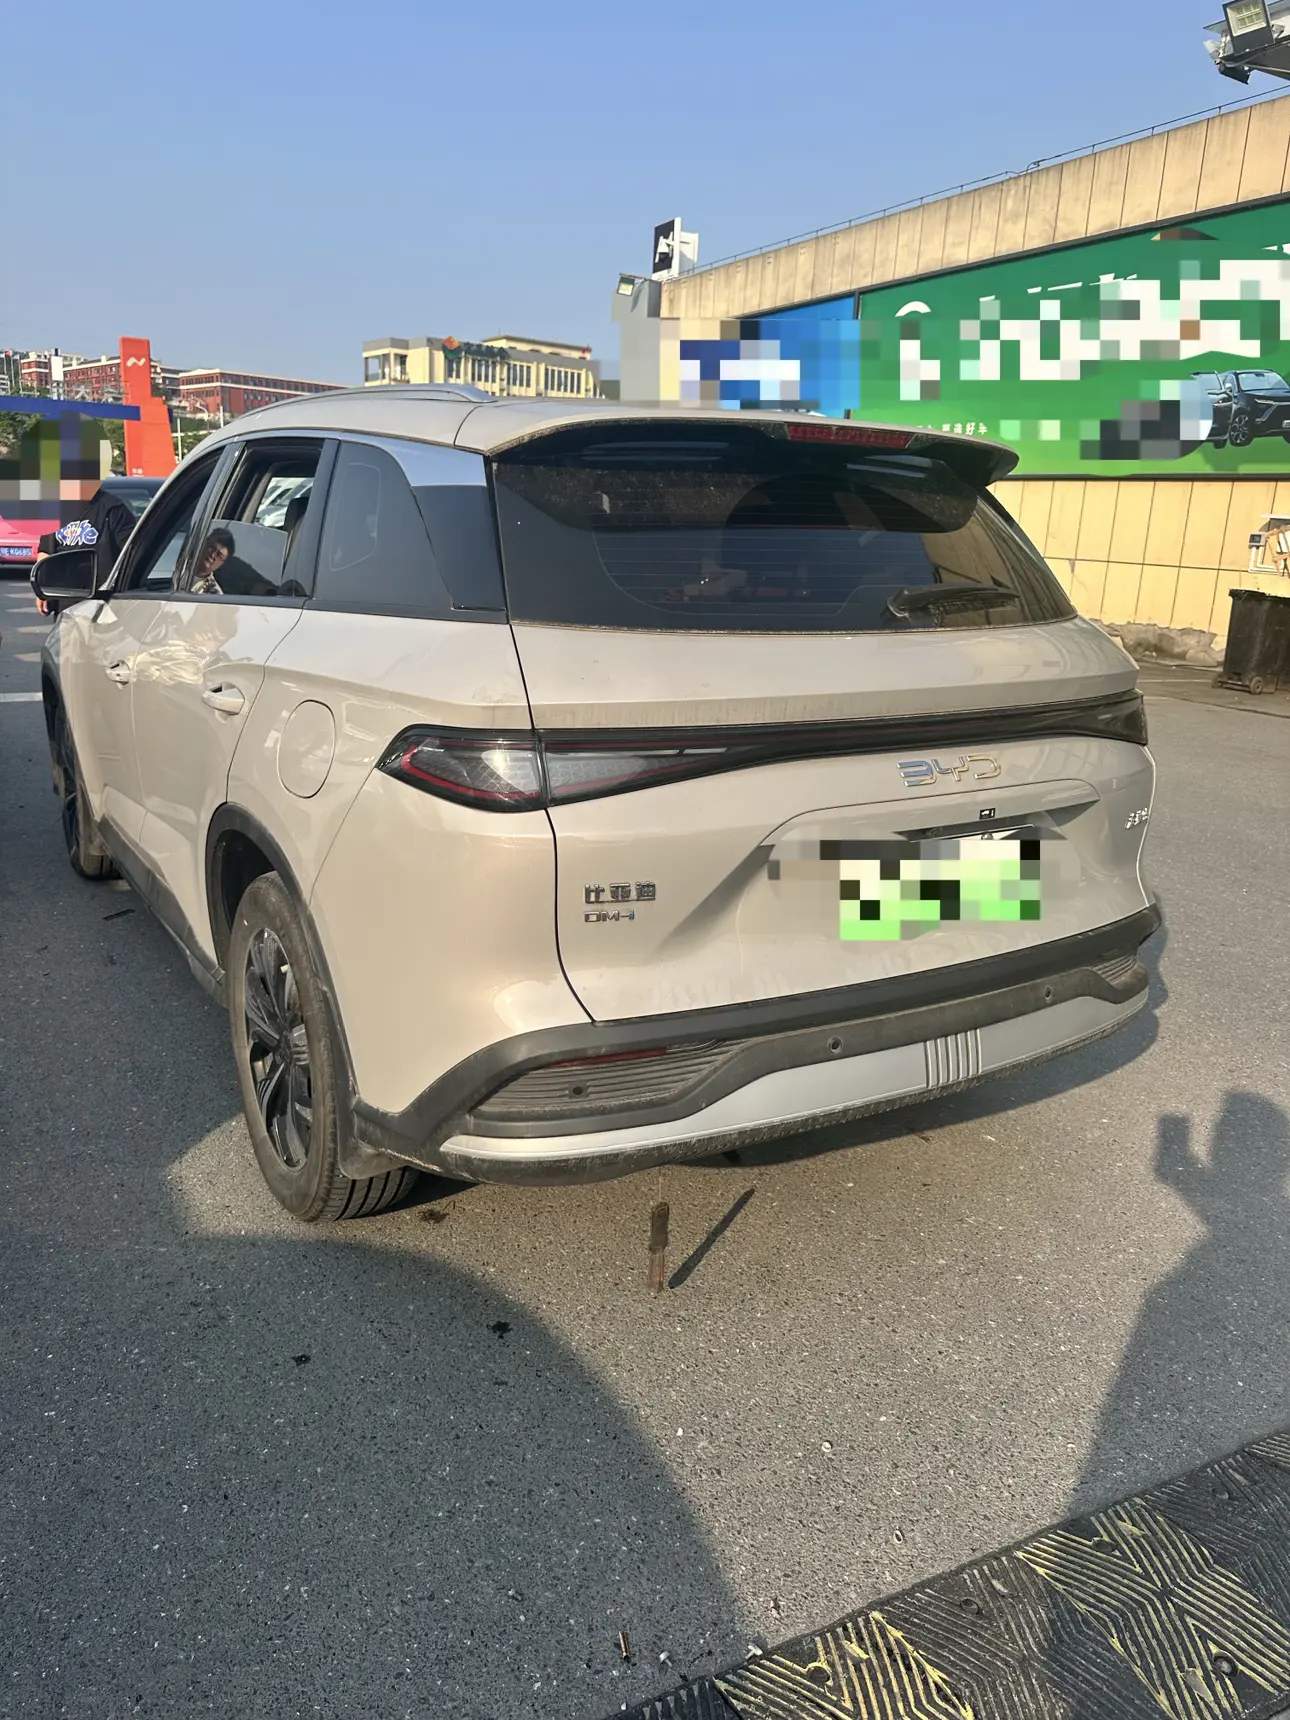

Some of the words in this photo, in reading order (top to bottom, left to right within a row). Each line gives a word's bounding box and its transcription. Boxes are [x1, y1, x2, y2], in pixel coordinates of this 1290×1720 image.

[897, 753, 1001, 787] BYD
[584, 881, 656, 904] 比亚迪
